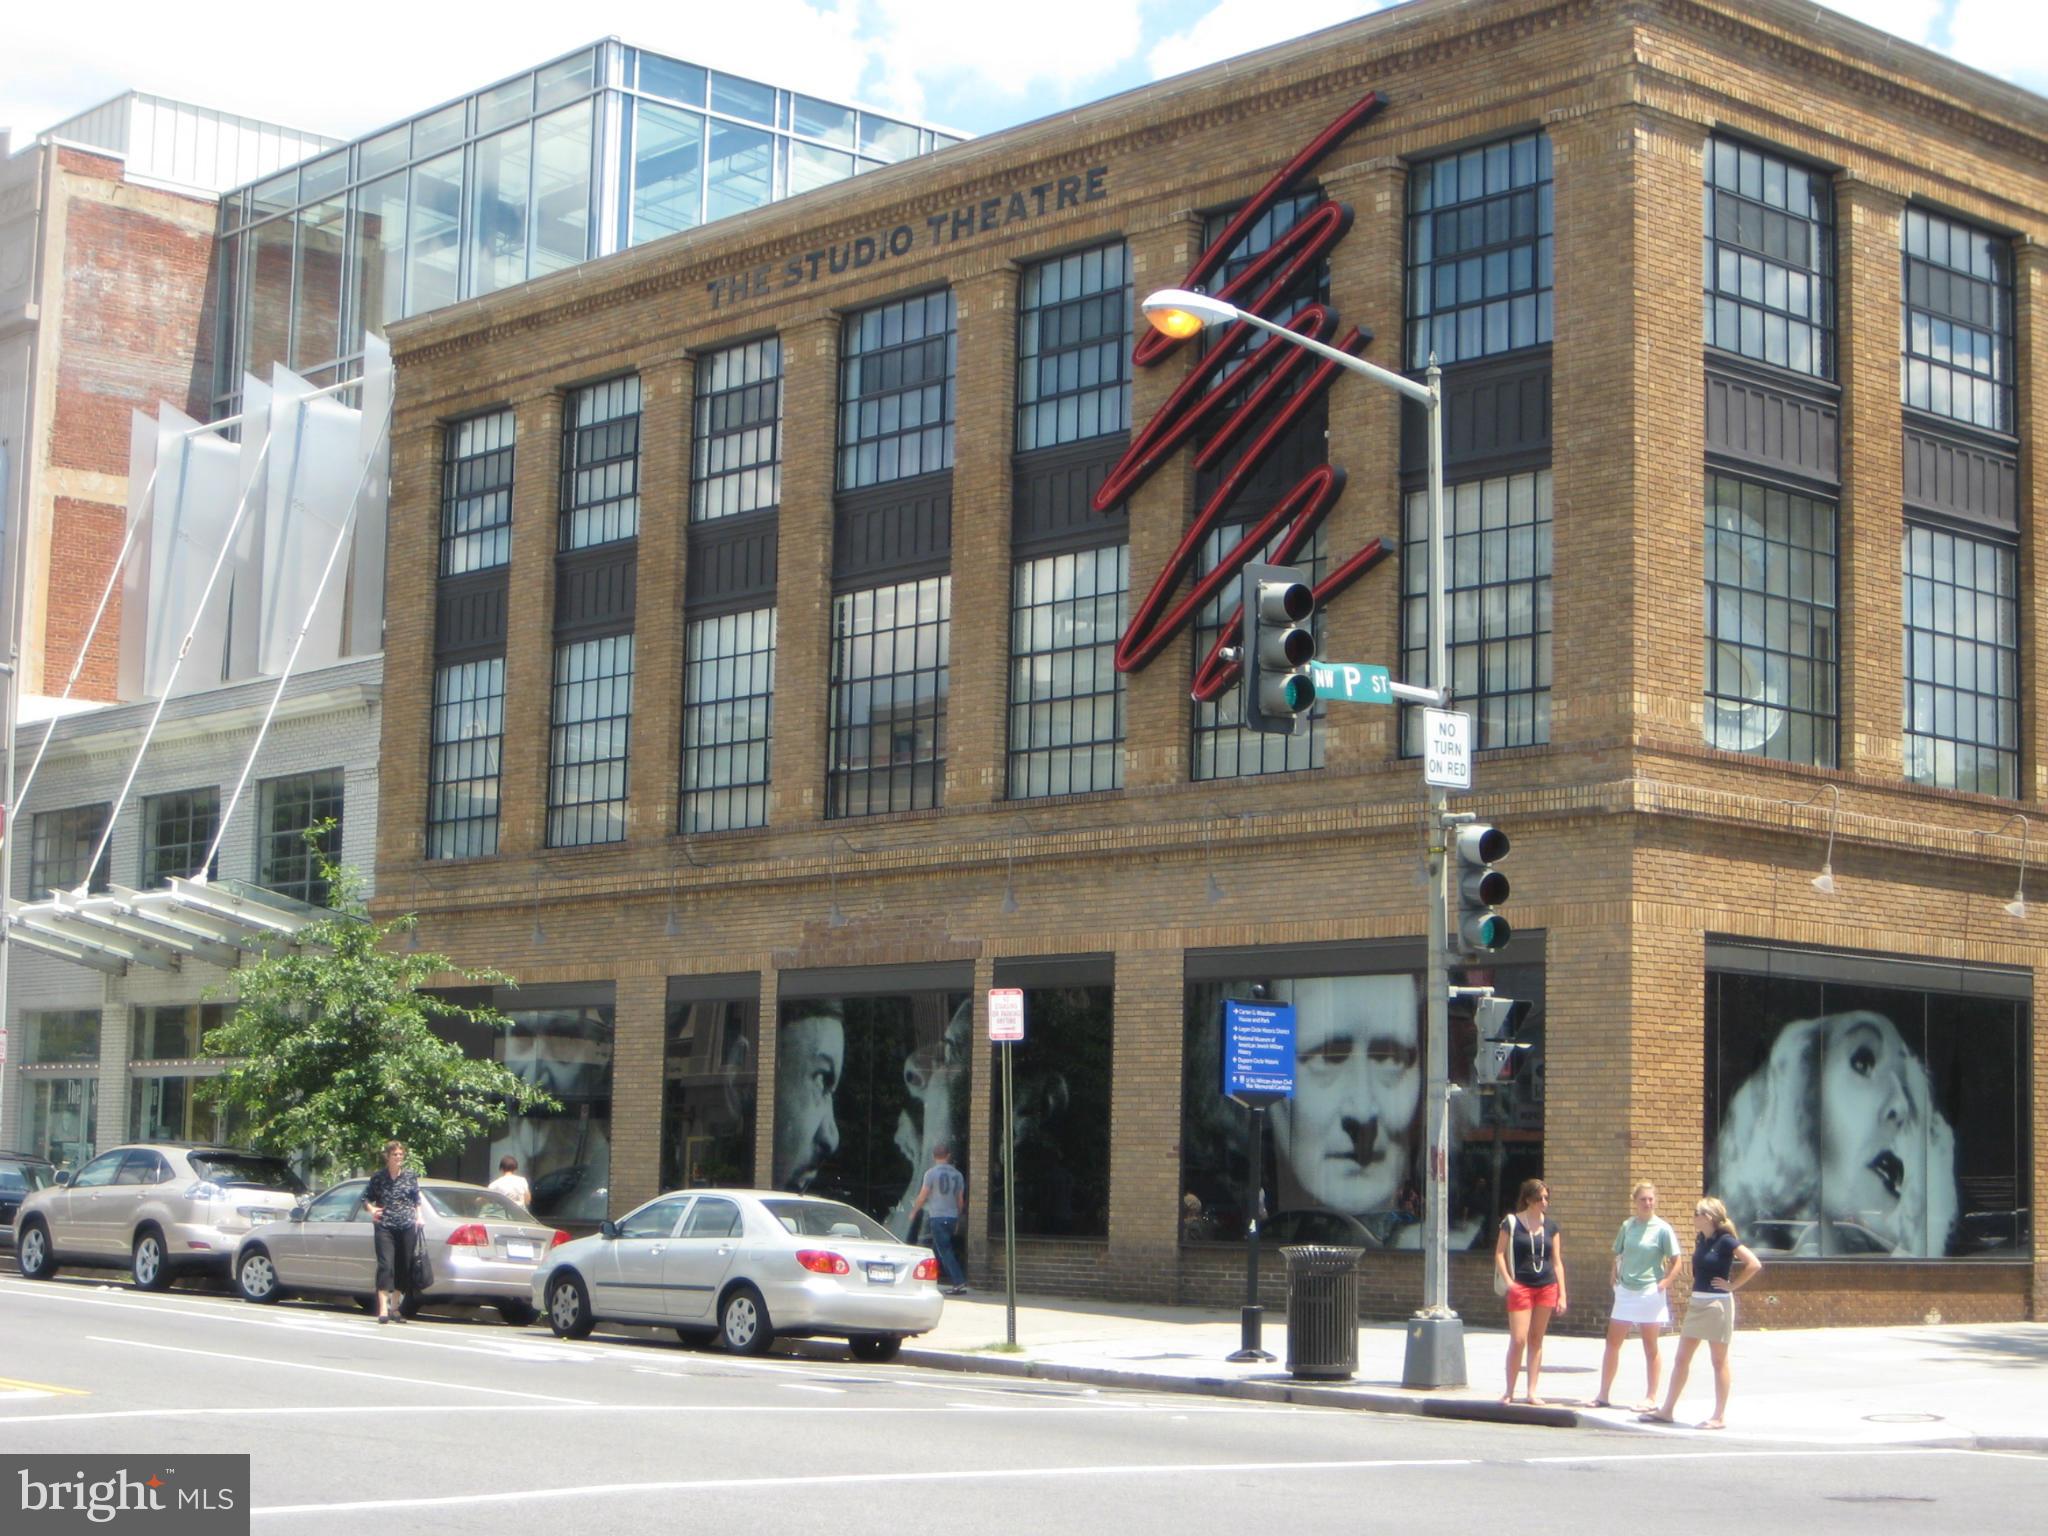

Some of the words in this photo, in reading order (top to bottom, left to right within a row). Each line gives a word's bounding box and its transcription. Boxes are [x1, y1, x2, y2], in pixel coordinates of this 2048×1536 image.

[707, 262, 771, 309] THE
[782, 225, 913, 289] STUDIO
[927, 165, 1108, 246] THEATRE
[1315, 669, 1334, 689] NW
[1343, 665, 1361, 697] P
[1372, 674, 1387, 694] ST
[1439, 721, 1456, 737] NO
[1434, 740, 1462, 757] TURN
[1429, 759, 1443, 774] ON
[1447, 760, 1466, 777] RED
[67, 1078, 81, 1105] The
